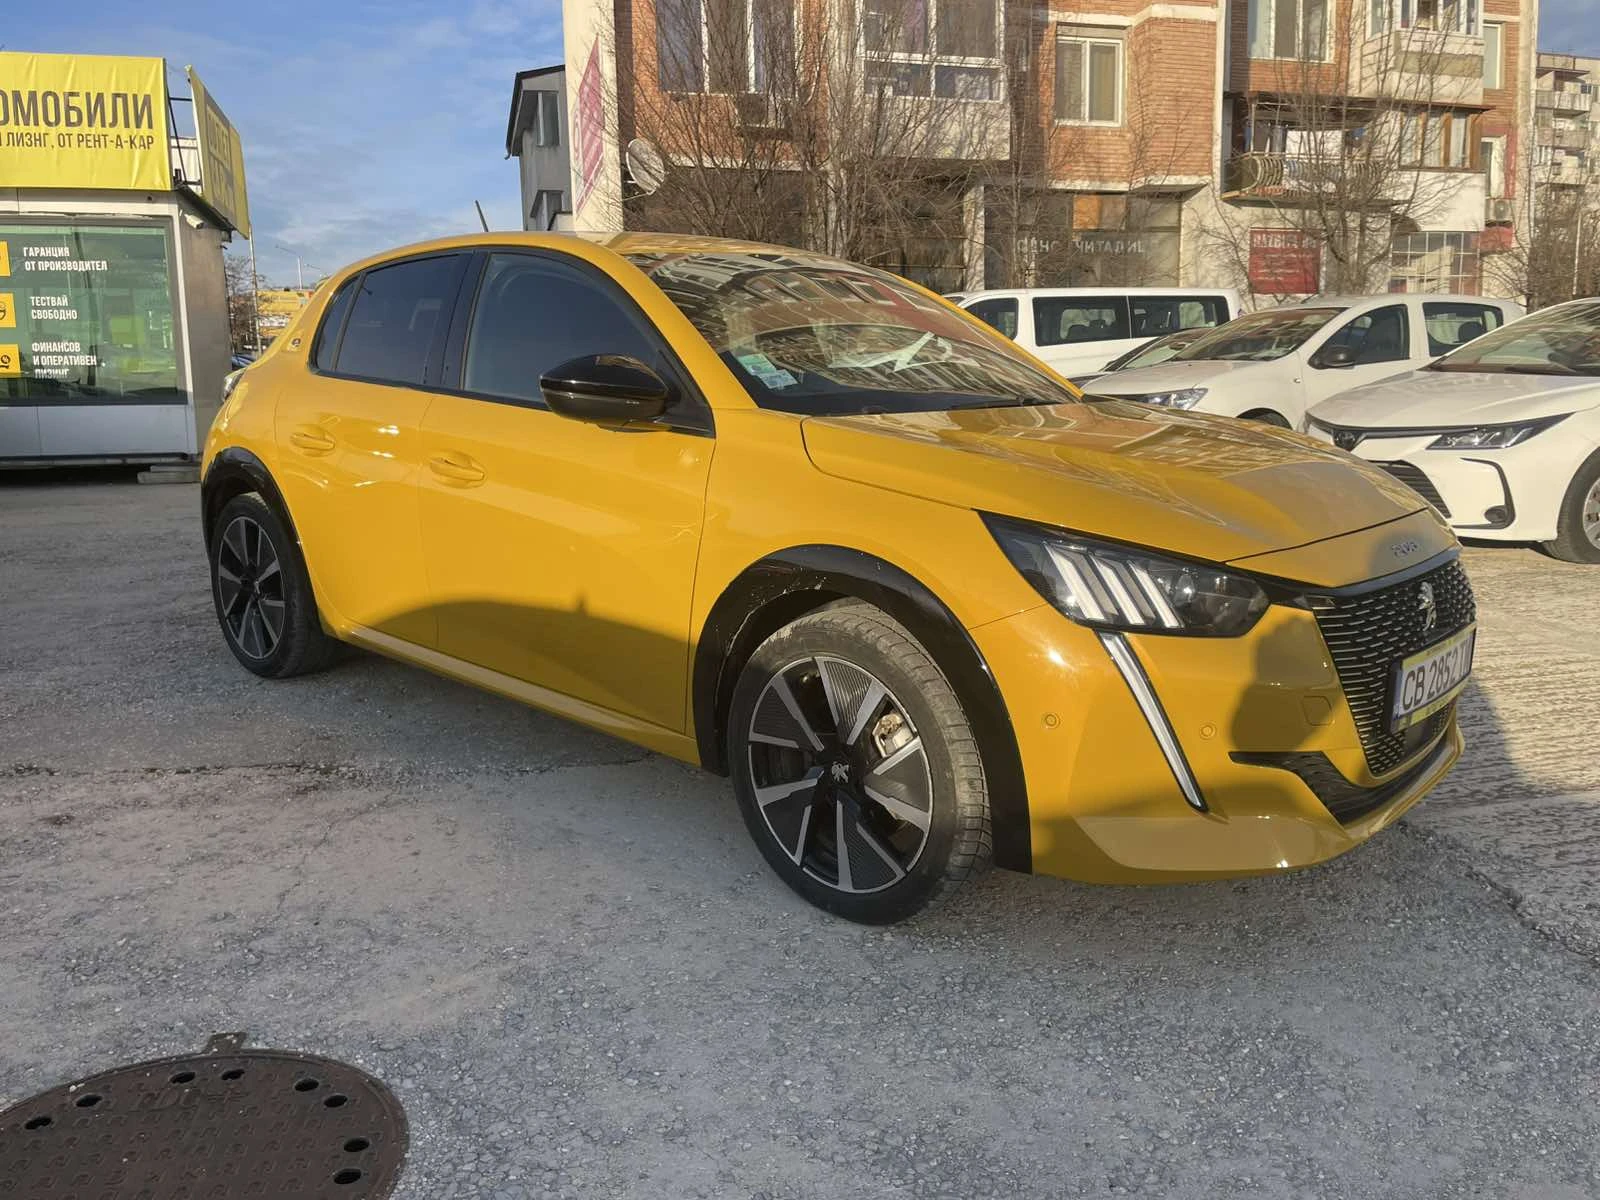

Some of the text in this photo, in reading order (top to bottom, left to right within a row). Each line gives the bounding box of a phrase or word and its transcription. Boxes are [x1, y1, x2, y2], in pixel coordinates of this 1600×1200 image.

[57, 132, 72, 148] ОТ
[77, 133, 154, 150] РЕНТ-А-КАР
[23, 247, 70, 258] ГАРАНЦИЯ
[25, 260, 108, 272] ОТ ПРОИЗВОДИТЕЛ
[31, 295, 69, 306] ТЕСТВАЙ
[31, 309, 78, 320] СВОБОДНО
[32, 342, 81, 352] ФИНАНСОВ
[33, 355, 97, 365] И ОПЕРАТИВЕН
